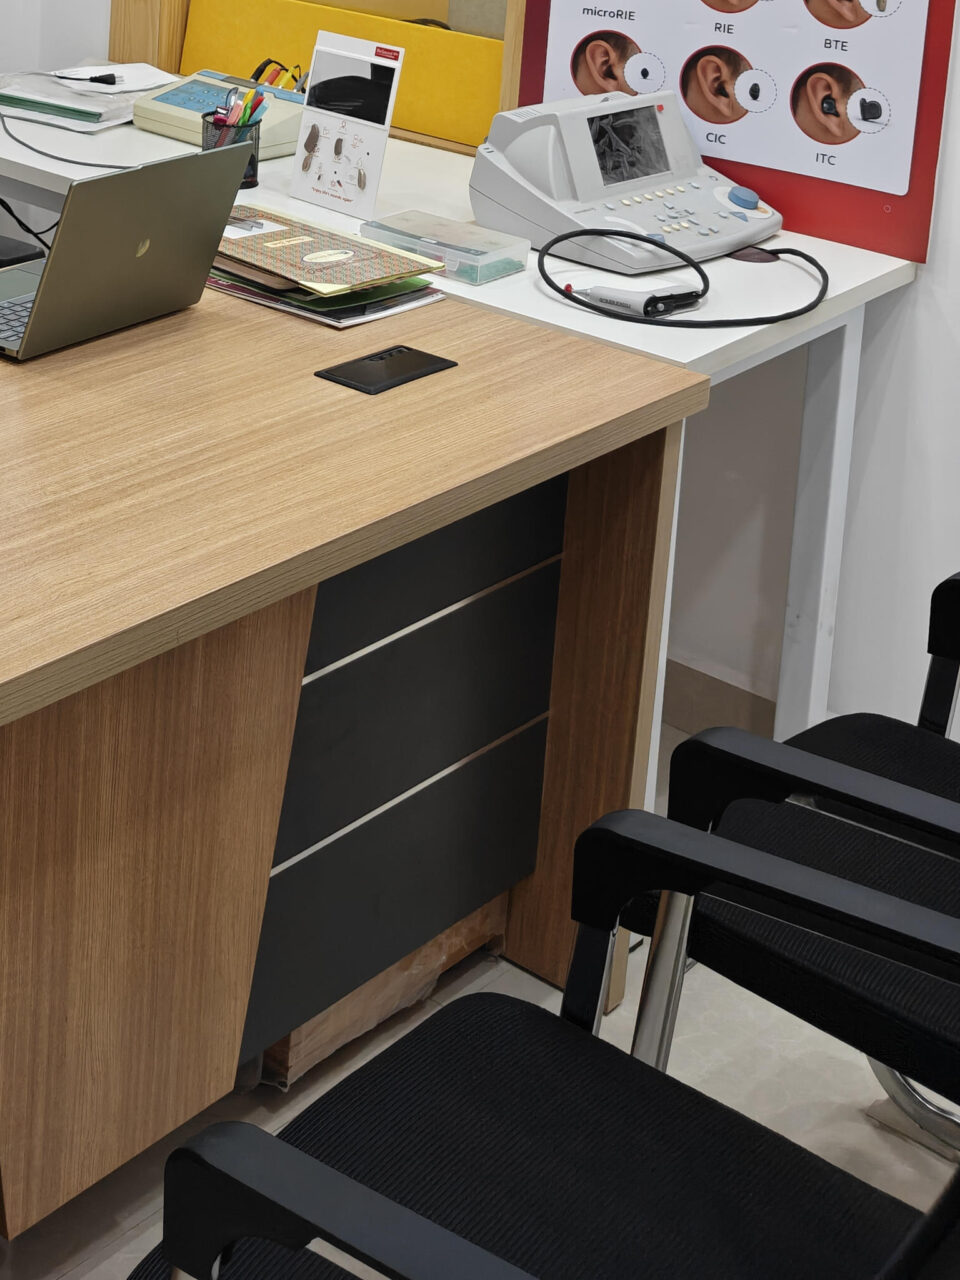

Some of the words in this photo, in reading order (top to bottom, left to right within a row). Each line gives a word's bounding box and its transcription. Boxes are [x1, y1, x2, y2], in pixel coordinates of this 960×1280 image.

[582, 6, 636, 21] microRIE
[714, 22, 735, 34] RIE
[823, 38, 849, 52] BTE
[705, 132, 727, 145] CIC
[815, 152, 837, 166] ITC
